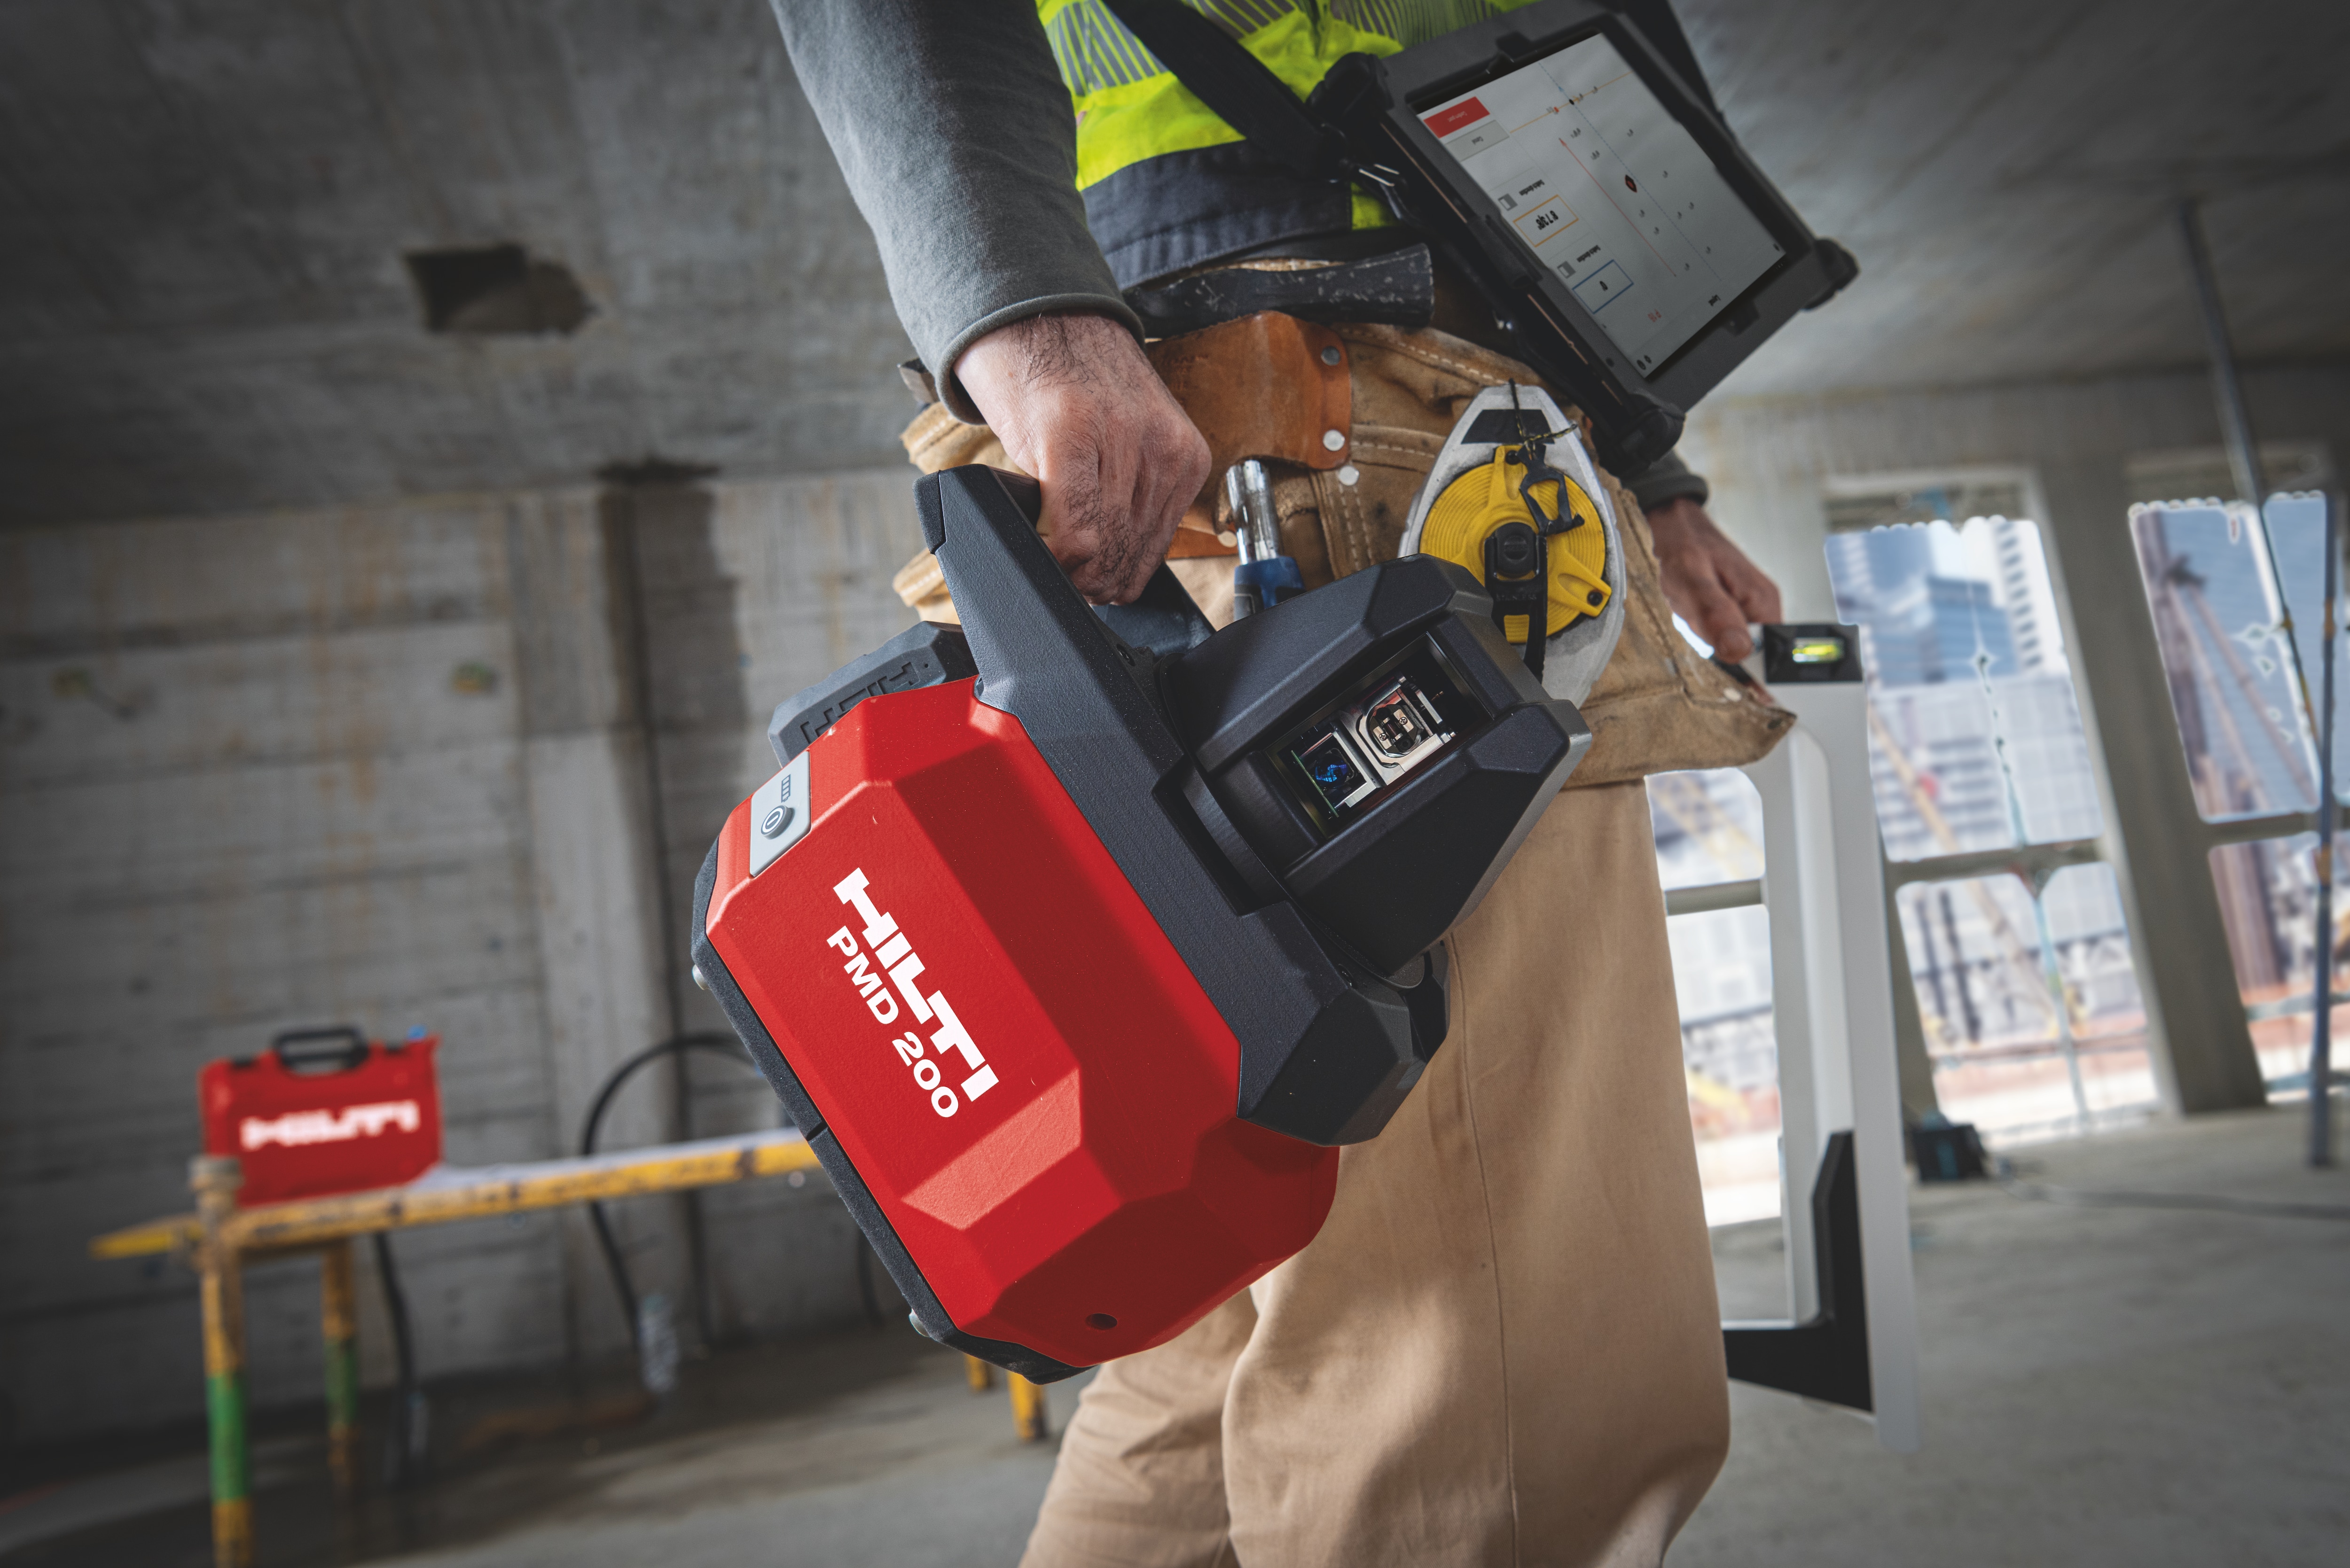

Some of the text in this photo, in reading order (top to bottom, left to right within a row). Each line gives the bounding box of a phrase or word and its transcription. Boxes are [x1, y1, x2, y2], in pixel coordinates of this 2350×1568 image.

[827, 926, 959, 1118] PMD 200
[833, 867, 999, 1101] HILTI
[240, 1100, 420, 1150] HILTI
